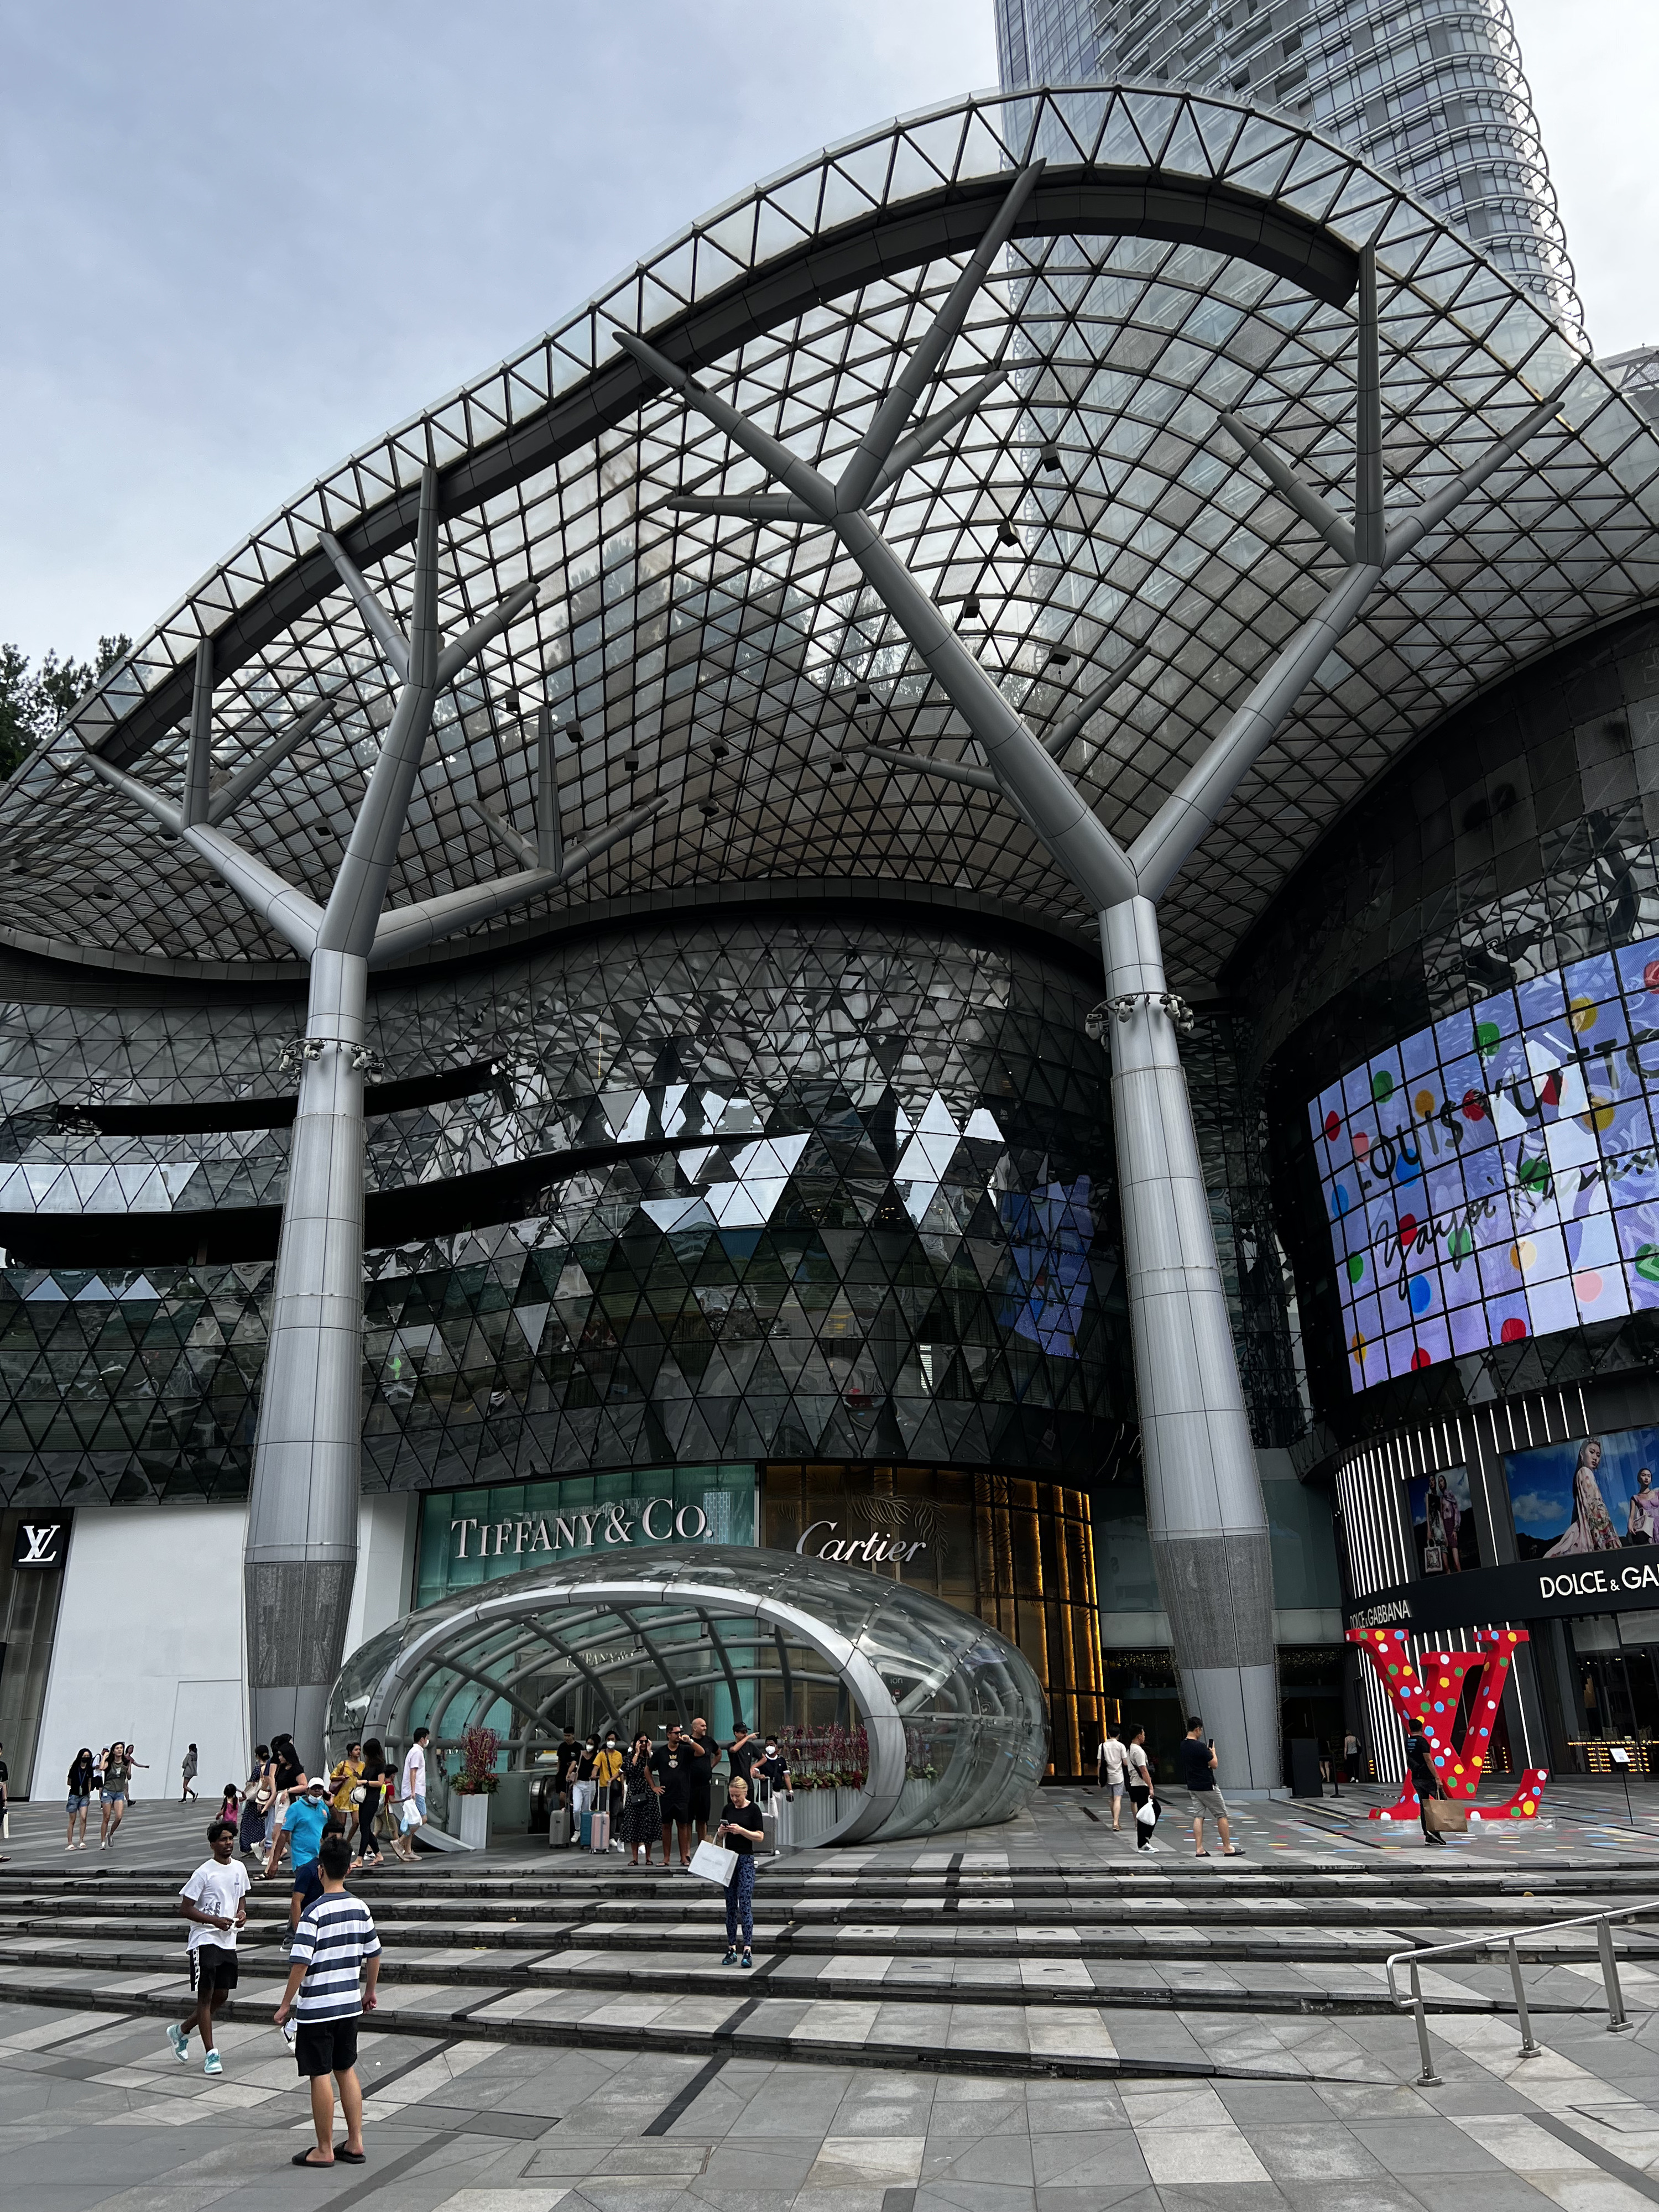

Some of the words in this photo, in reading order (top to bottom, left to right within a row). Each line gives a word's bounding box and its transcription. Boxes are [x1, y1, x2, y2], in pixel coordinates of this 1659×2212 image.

[451, 1513, 602, 1558] TIFFANY
[796, 1520, 926, 1562] Cartier
[1540, 1570, 1608, 1598] DOLCE
[1610, 1579, 1621, 1592] &
[1621, 1563, 1659, 1589] GA
[1349, 1610, 1366, 1630] DOLCE
[1367, 1599, 1412, 1626] GABBANA
